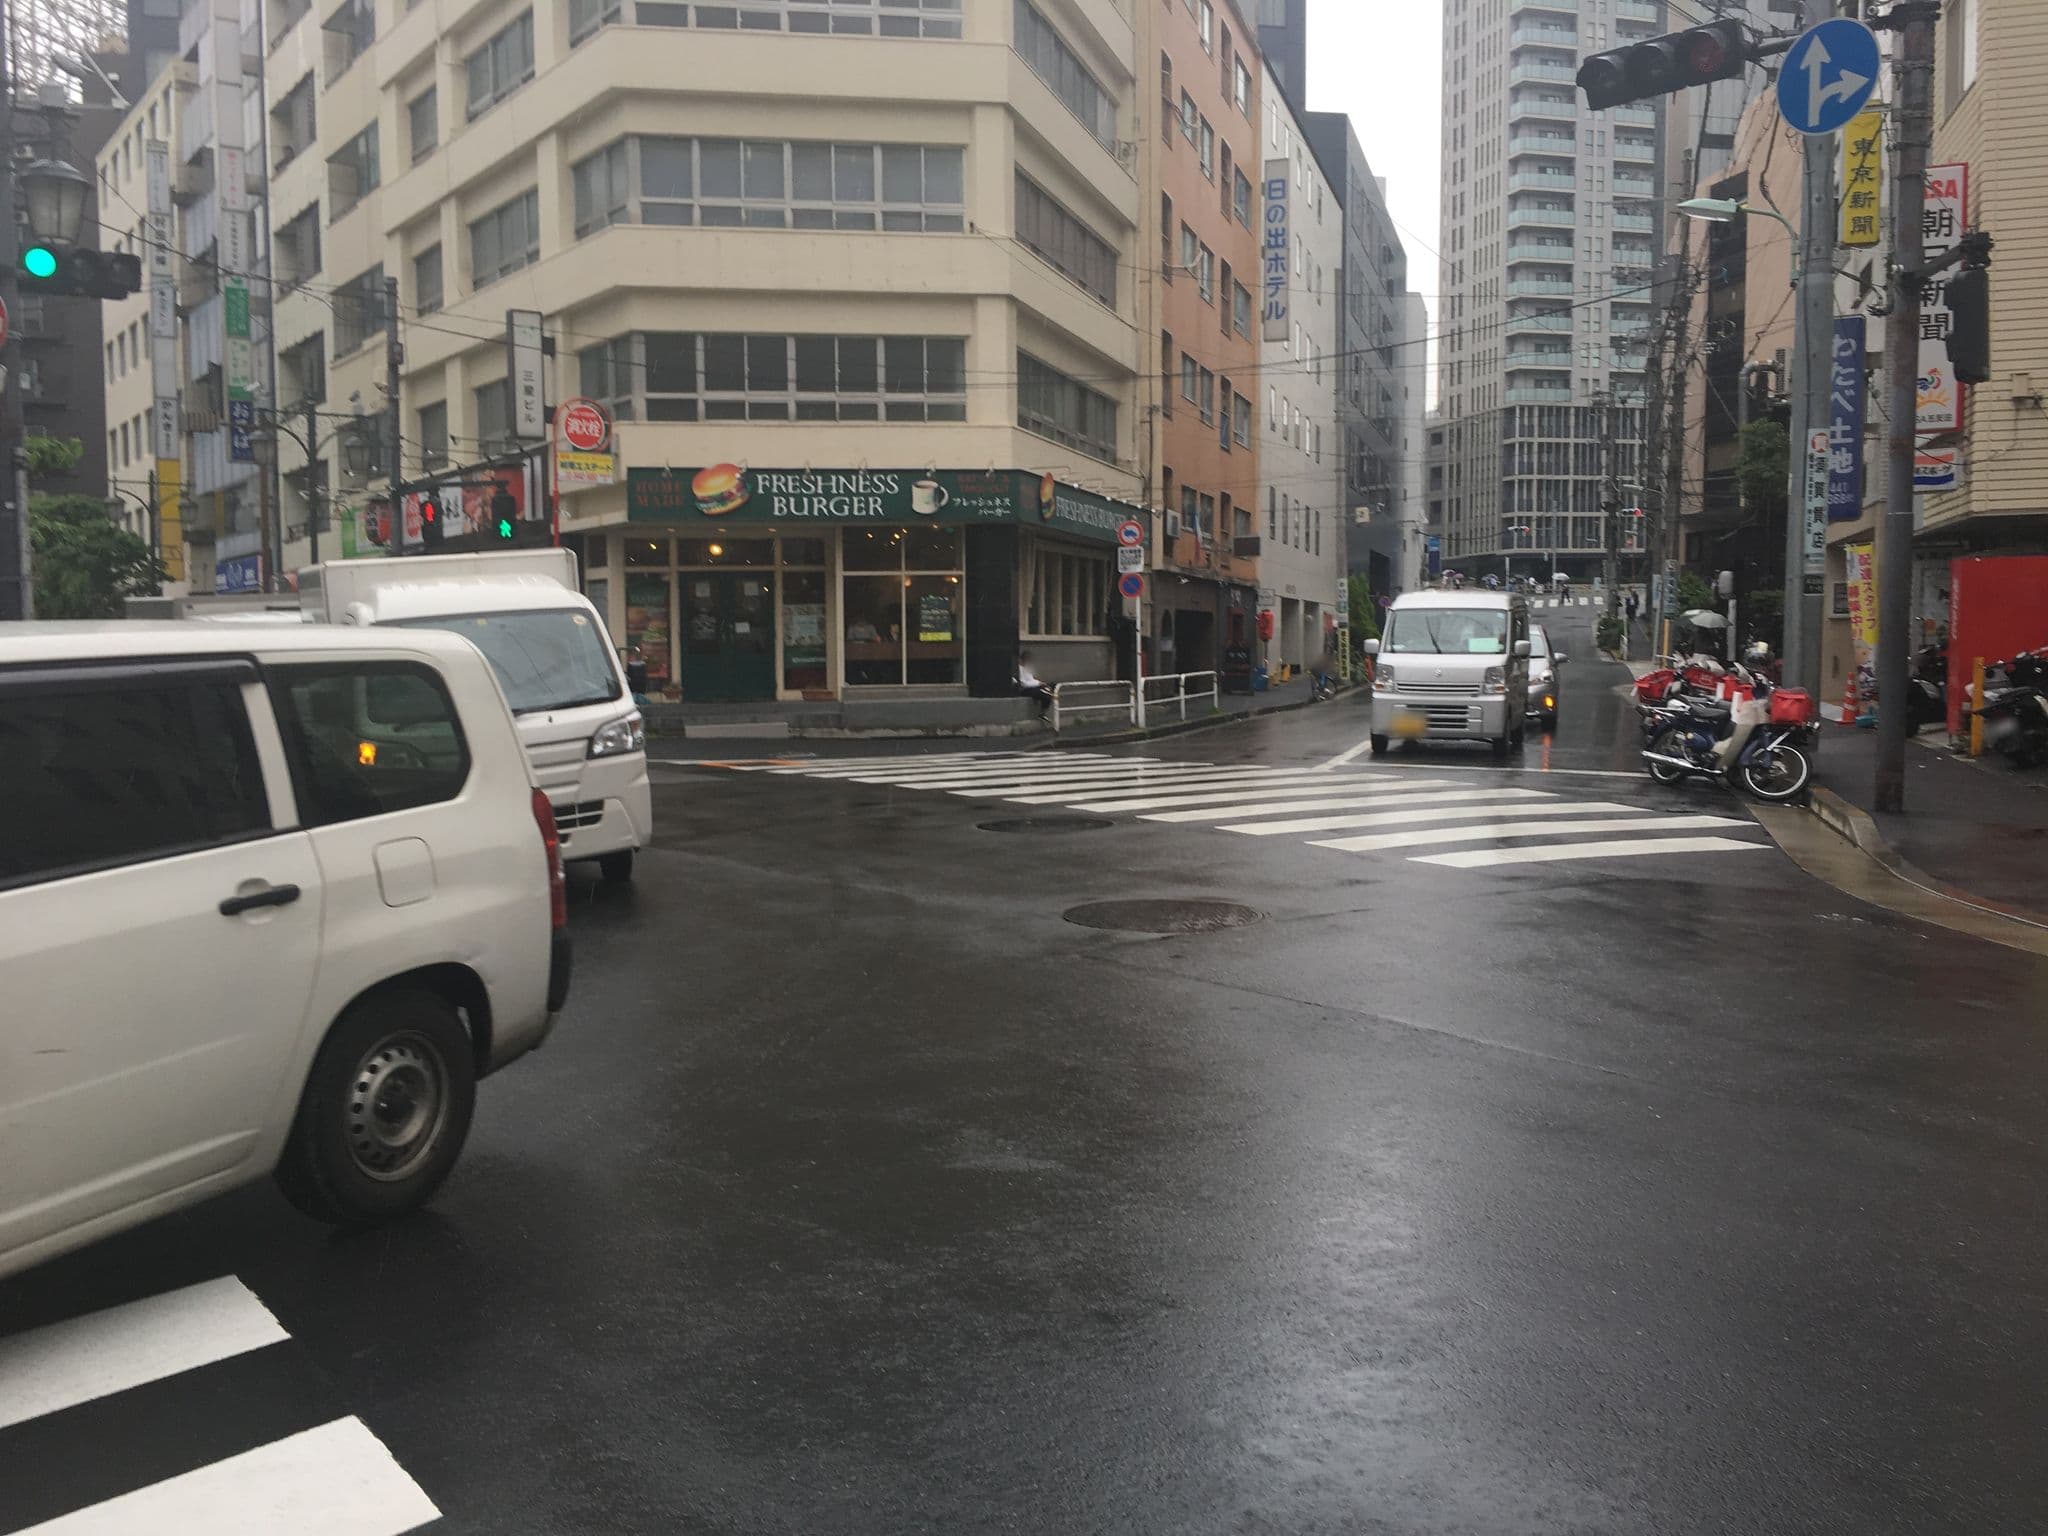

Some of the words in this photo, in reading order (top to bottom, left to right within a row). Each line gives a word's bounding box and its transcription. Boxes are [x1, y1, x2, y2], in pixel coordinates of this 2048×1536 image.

[1848, 138, 1876, 236] 東京新聞
[1923, 179, 1957, 198] SA
[1266, 178, 1287, 321] 日の出ホテル
[568, 416, 602, 437] 消火栓
[1830, 333, 1857, 474] わたべ土地
[756, 474, 900, 494] FRESHNESS
[773, 496, 885, 516] BURGER
[1858, 553, 1876, 629] 配達スタッフ
